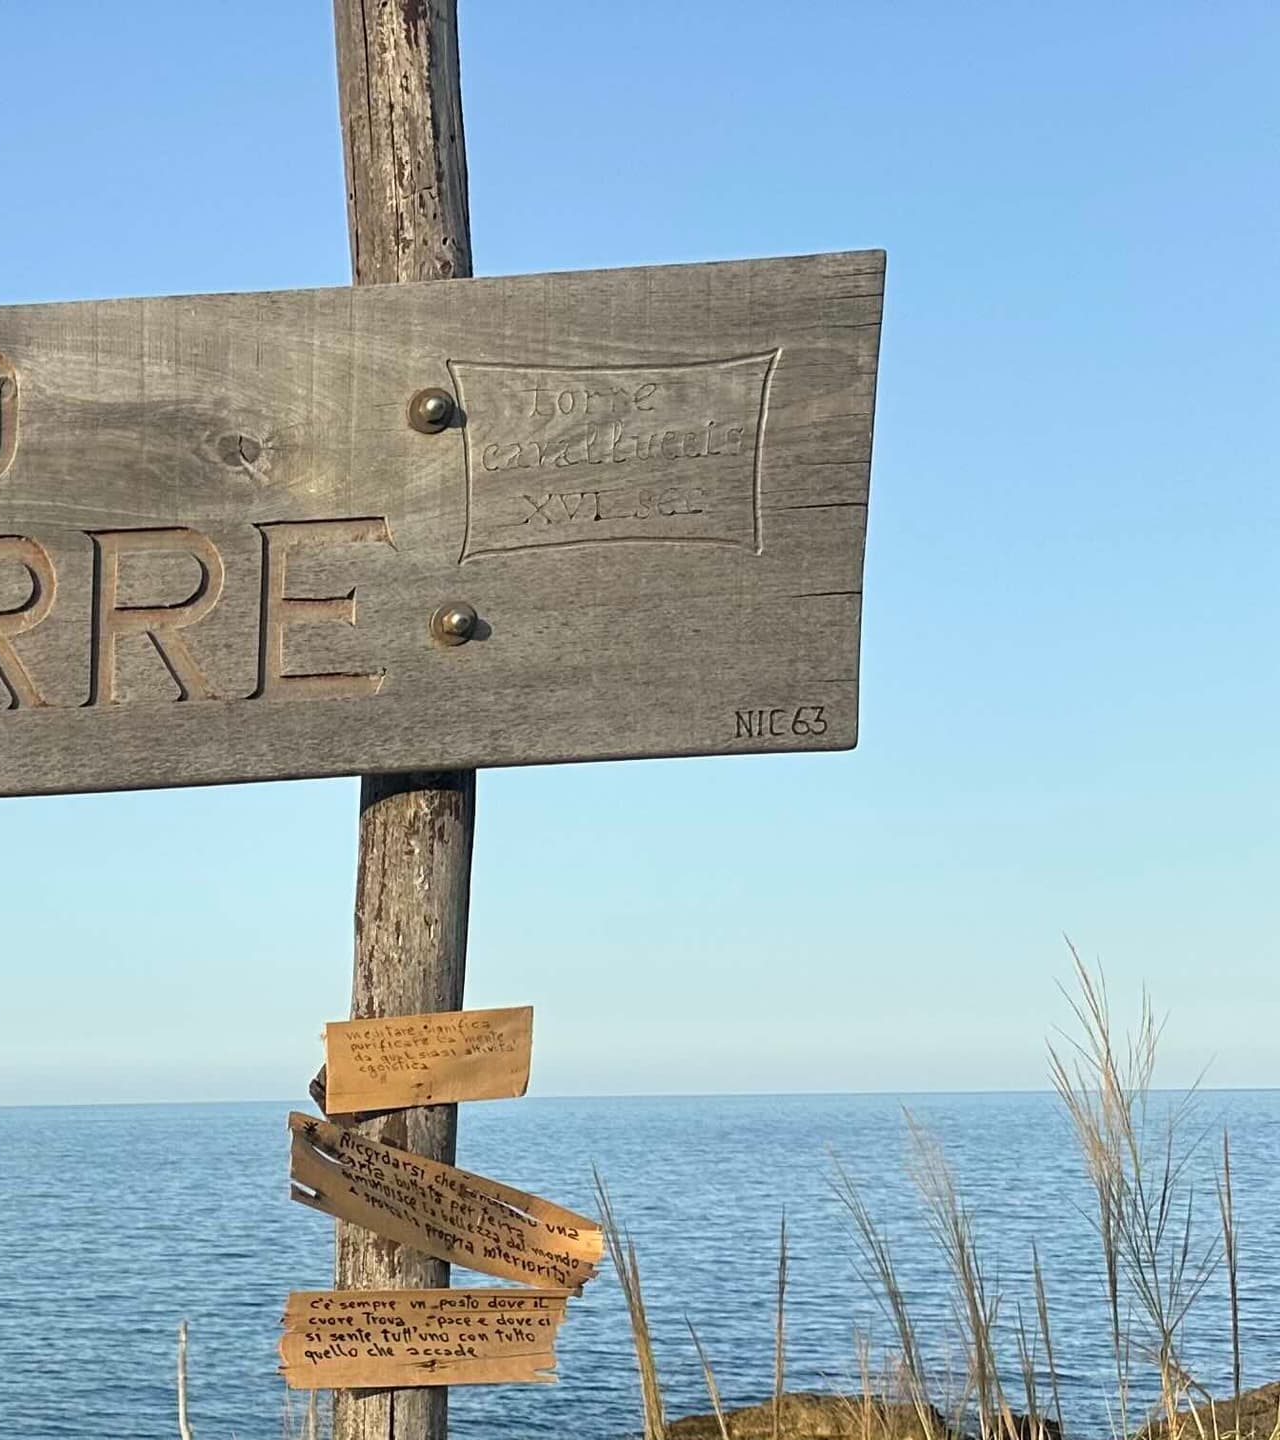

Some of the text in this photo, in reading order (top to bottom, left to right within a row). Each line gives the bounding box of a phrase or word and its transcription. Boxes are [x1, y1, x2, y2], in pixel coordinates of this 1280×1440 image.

[339, 1131, 425, 1180] Ricordarsi
[435, 1171, 457, 1191] che
[546, 1223, 579, 1241] una
[451, 1200, 475, 1216] per
[531, 1247, 579, 1269] mondo
[340, 1299, 396, 1312] sempre
[440, 1295, 479, 1312] posto
[488, 1296, 526, 1309] dove
[309, 1315, 354, 1326] cuore
[437, 1316, 472, 1328] pace
[478, 1317, 489, 1326] e
[496, 1313, 535, 1327] dove
[538, 1315, 552, 1327] ci
[305, 1328, 322, 1343] si
[330, 1328, 372, 1343] sente
[459, 1331, 490, 1342] con
[304, 1345, 477, 1365] quello che accade
